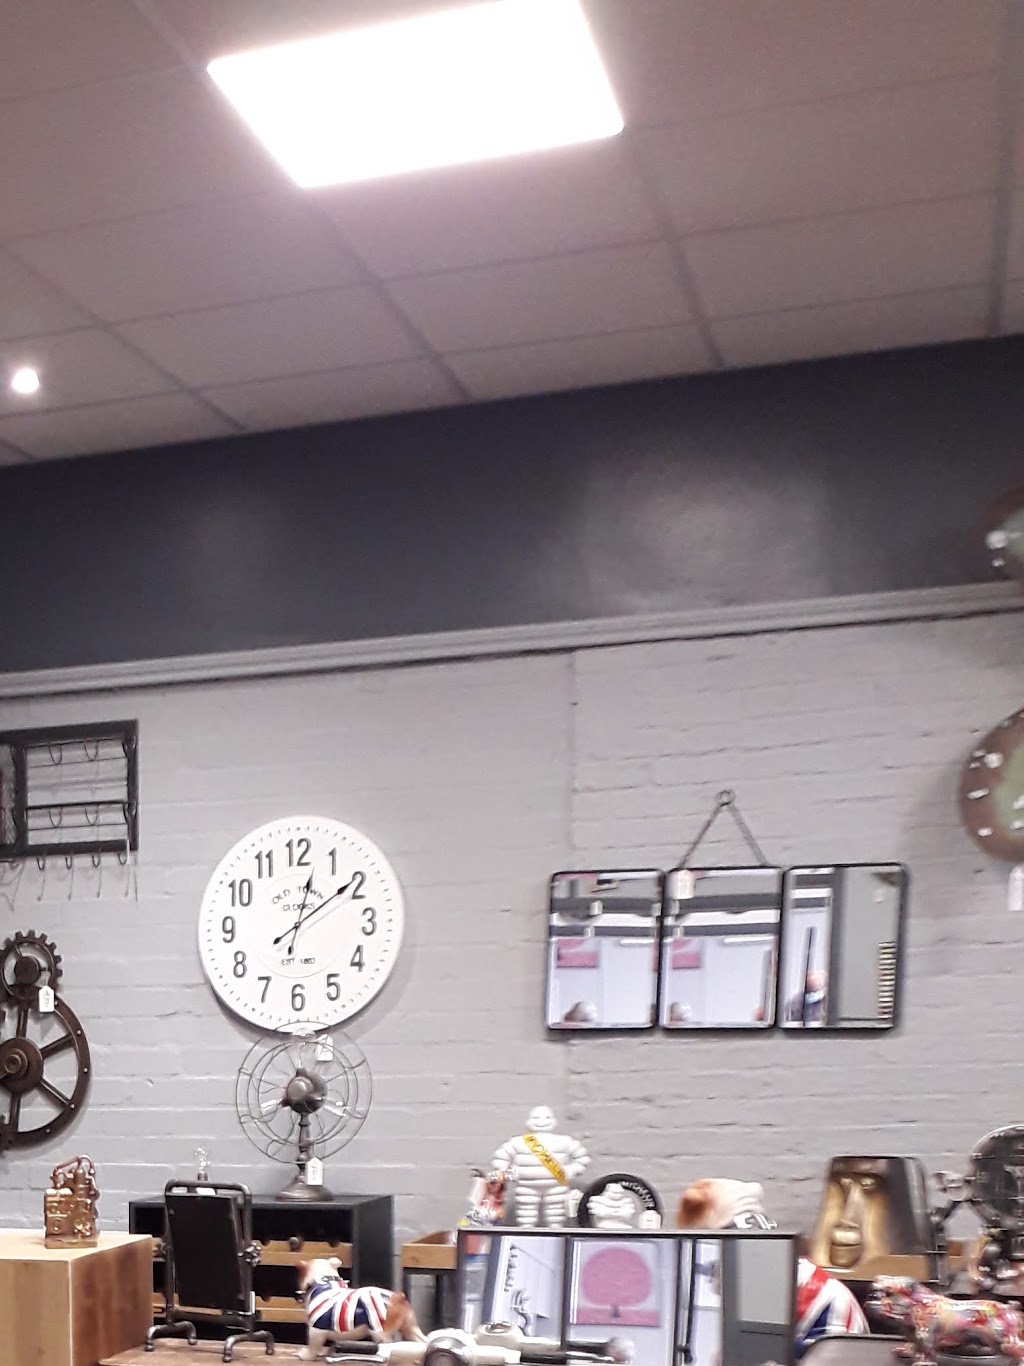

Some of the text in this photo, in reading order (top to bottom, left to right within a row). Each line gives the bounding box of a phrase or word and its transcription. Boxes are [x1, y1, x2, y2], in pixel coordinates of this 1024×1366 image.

[255, 849, 274, 879] 11
[285, 838, 312, 868] 12
[328, 847, 337, 876] 1
[228, 878, 253, 908] 10
[351, 871, 367, 900] 2
[221, 916, 236, 944] 9
[361, 907, 377, 937] 3
[232, 950, 247, 979] 8
[350, 944, 366, 973] 4
[257, 975, 273, 1004] 7
[291, 983, 306, 1012] 6
[326, 973, 342, 1002] 5
